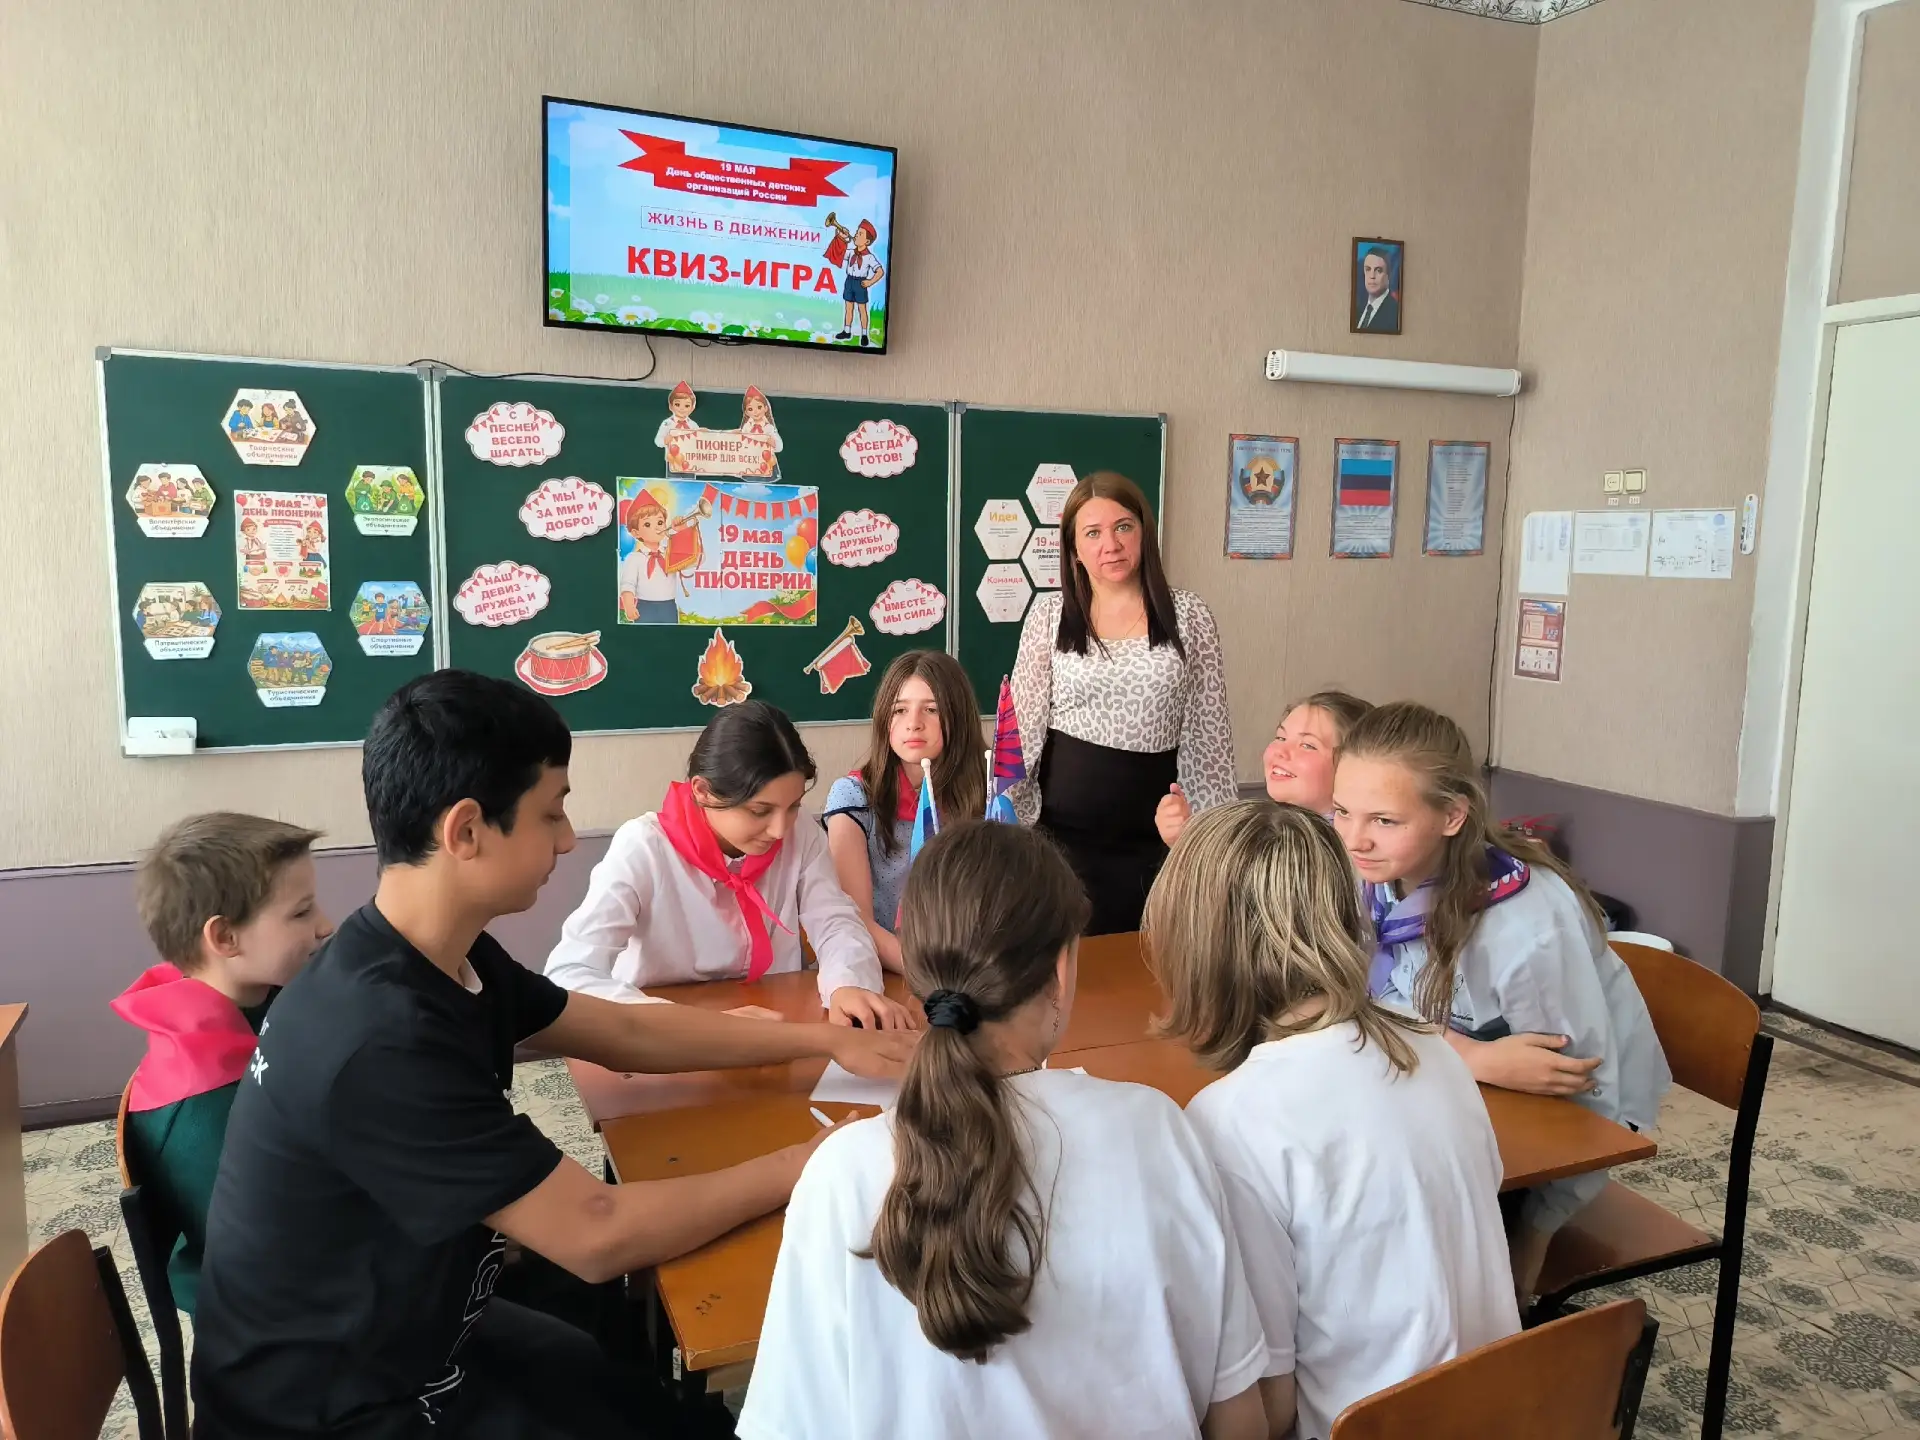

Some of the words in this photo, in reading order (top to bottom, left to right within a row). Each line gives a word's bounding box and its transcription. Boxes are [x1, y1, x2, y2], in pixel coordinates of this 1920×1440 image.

[720, 162, 732, 172] 19
[734, 165, 756, 175] МАЯ
[665, 167, 692, 178] День
[694, 171, 766, 188] общественных
[768, 182, 807, 193] детских
[686, 182, 750, 197] организаций
[752, 189, 787, 202] России
[647, 211, 708, 230] ЖИЗНЬ
[714, 220, 724, 232] В
[728, 222, 822, 243] ДВИЖЕНИИ
[627, 245, 838, 294] КВИЗ-ИГРА
[509, 411, 517, 420] С
[489, 421, 540, 434] ПЕСНЕЙ
[491, 435, 541, 446] ВЕСЕЛО
[696, 439, 742, 452] ПИОНЕР
[856, 439, 904, 452] ВСЕГДА
[490, 448, 545, 459] ШАГАТЬ!
[685, 452, 718, 463] ПРИМЕР
[720, 454, 736, 463] ДЛЯ
[739, 454, 760, 465] ВСЕХ!
[859, 452, 903, 466] ГОТОВ!
[1036, 476, 1075, 486] Действие
[258, 498, 273, 508] 19
[275, 499, 302, 508] МАЯ
[552, 491, 576, 503] МЫ
[242, 508, 269, 517] ДЕНЬ
[271, 508, 323, 518] ПИОНЕРИИ
[536, 508, 553, 520] ЗА
[556, 503, 584, 517] МИР
[589, 501, 598, 512] И
[989, 511, 1018, 523] Идея
[545, 515, 595, 533] ДОБРО!
[840, 524, 878, 537] КОСТЁР
[718, 524, 739, 543] 19
[742, 528, 783, 545] мая
[839, 534, 883, 550] ДРУЖБЫ
[1035, 537, 1047, 547] 19
[831, 548, 863, 562] ГОРИТ
[865, 543, 894, 556] ЯРКО!
[720, 551, 784, 571] ДЕНЬ
[485, 573, 513, 586] НАШ
[694, 570, 812, 590] ПИОНЕРИИ
[987, 576, 1023, 585] Команда
[481, 584, 521, 601] ДЕВИЗ
[474, 596, 525, 616] ДРУЖБА
[527, 592, 536, 602] И
[884, 597, 926, 612] ВМЕСТЕ
[487, 606, 530, 622] ЧЕСТЬ!
[883, 614, 902, 625] МЫ
[904, 607, 936, 620] СИЛА!
